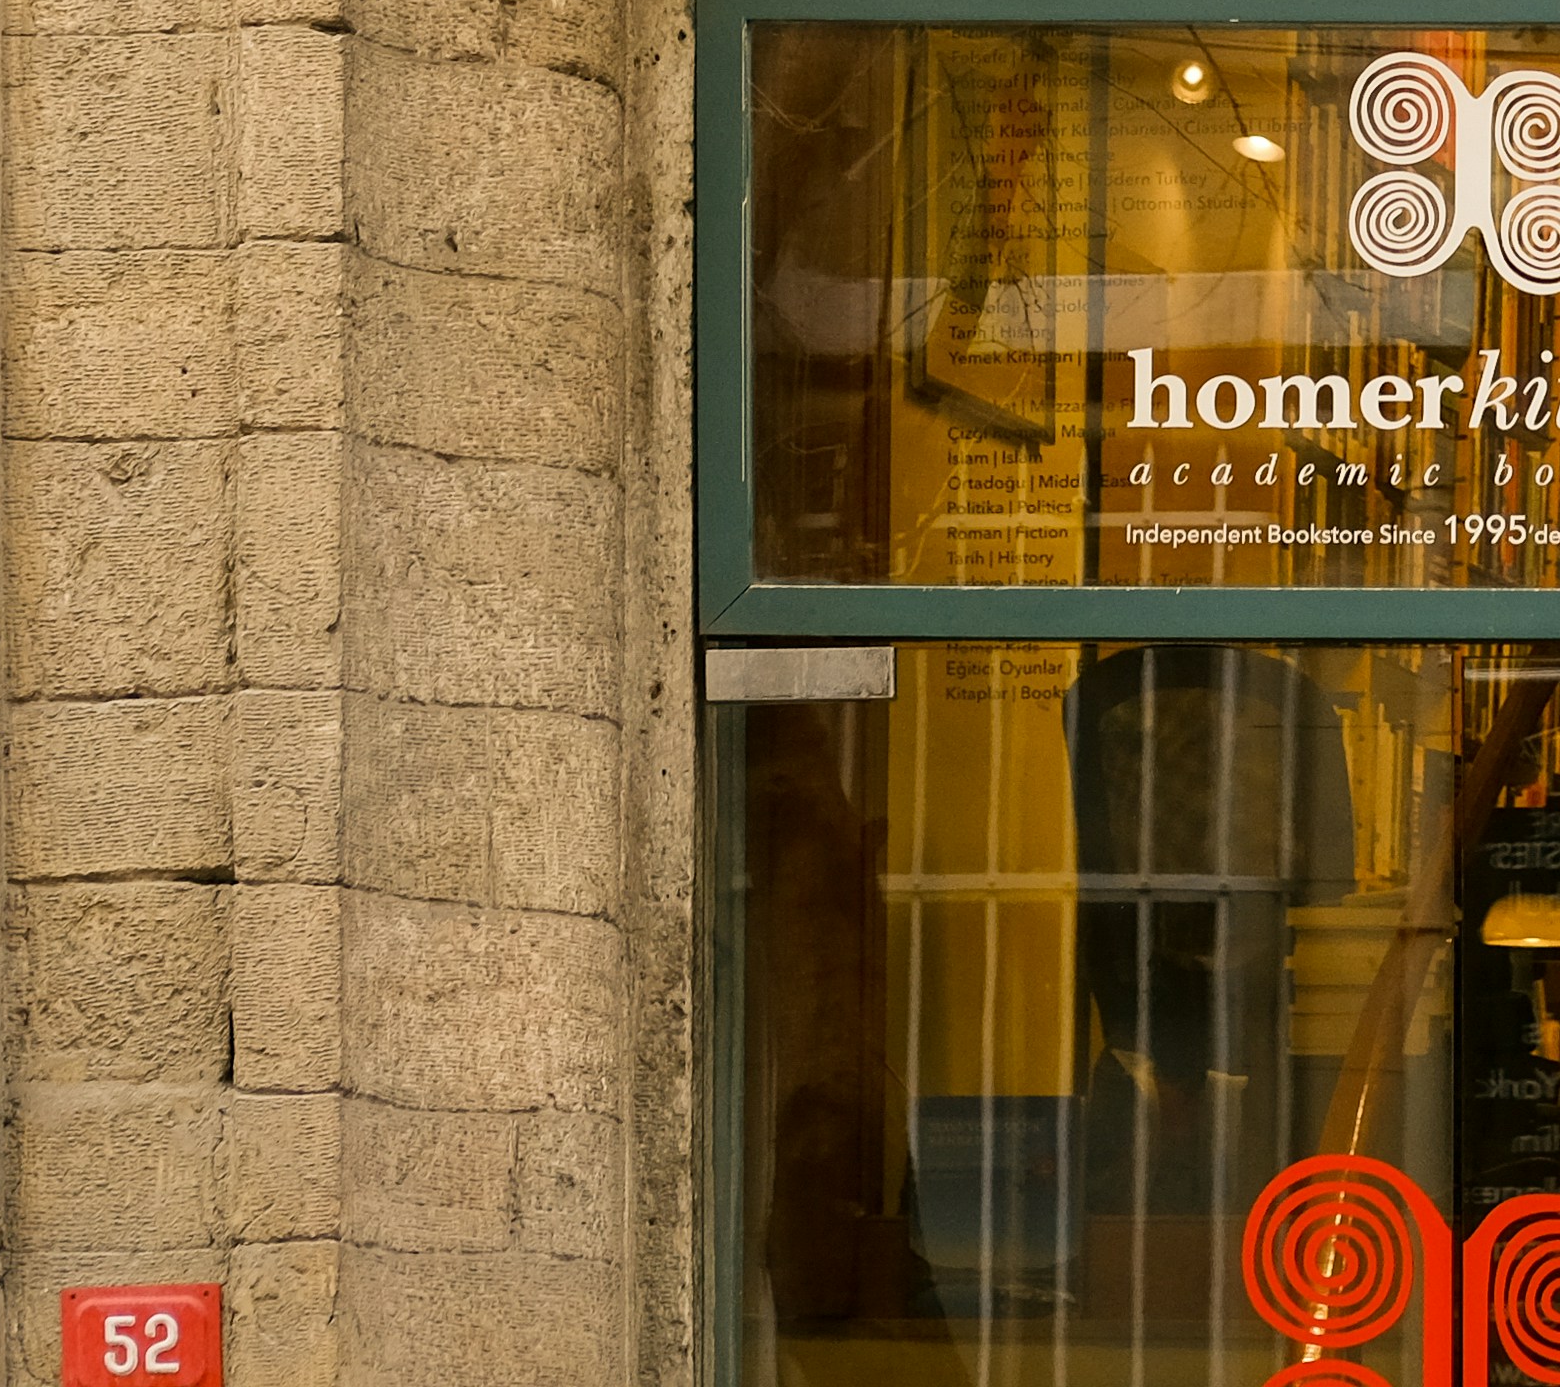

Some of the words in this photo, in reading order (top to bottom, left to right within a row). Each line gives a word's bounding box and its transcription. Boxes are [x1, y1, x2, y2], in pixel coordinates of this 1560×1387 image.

[1128, 453, 1441, 486] academic
[946, 526, 1003, 541] Roman
[1126, 523, 1262, 549] Independent
[1267, 523, 1373, 545] Bookstore
[1379, 523, 1436, 545] Since
[999, 658, 1064, 680] Oyunlar
[103, 1312, 180, 1376] 52
